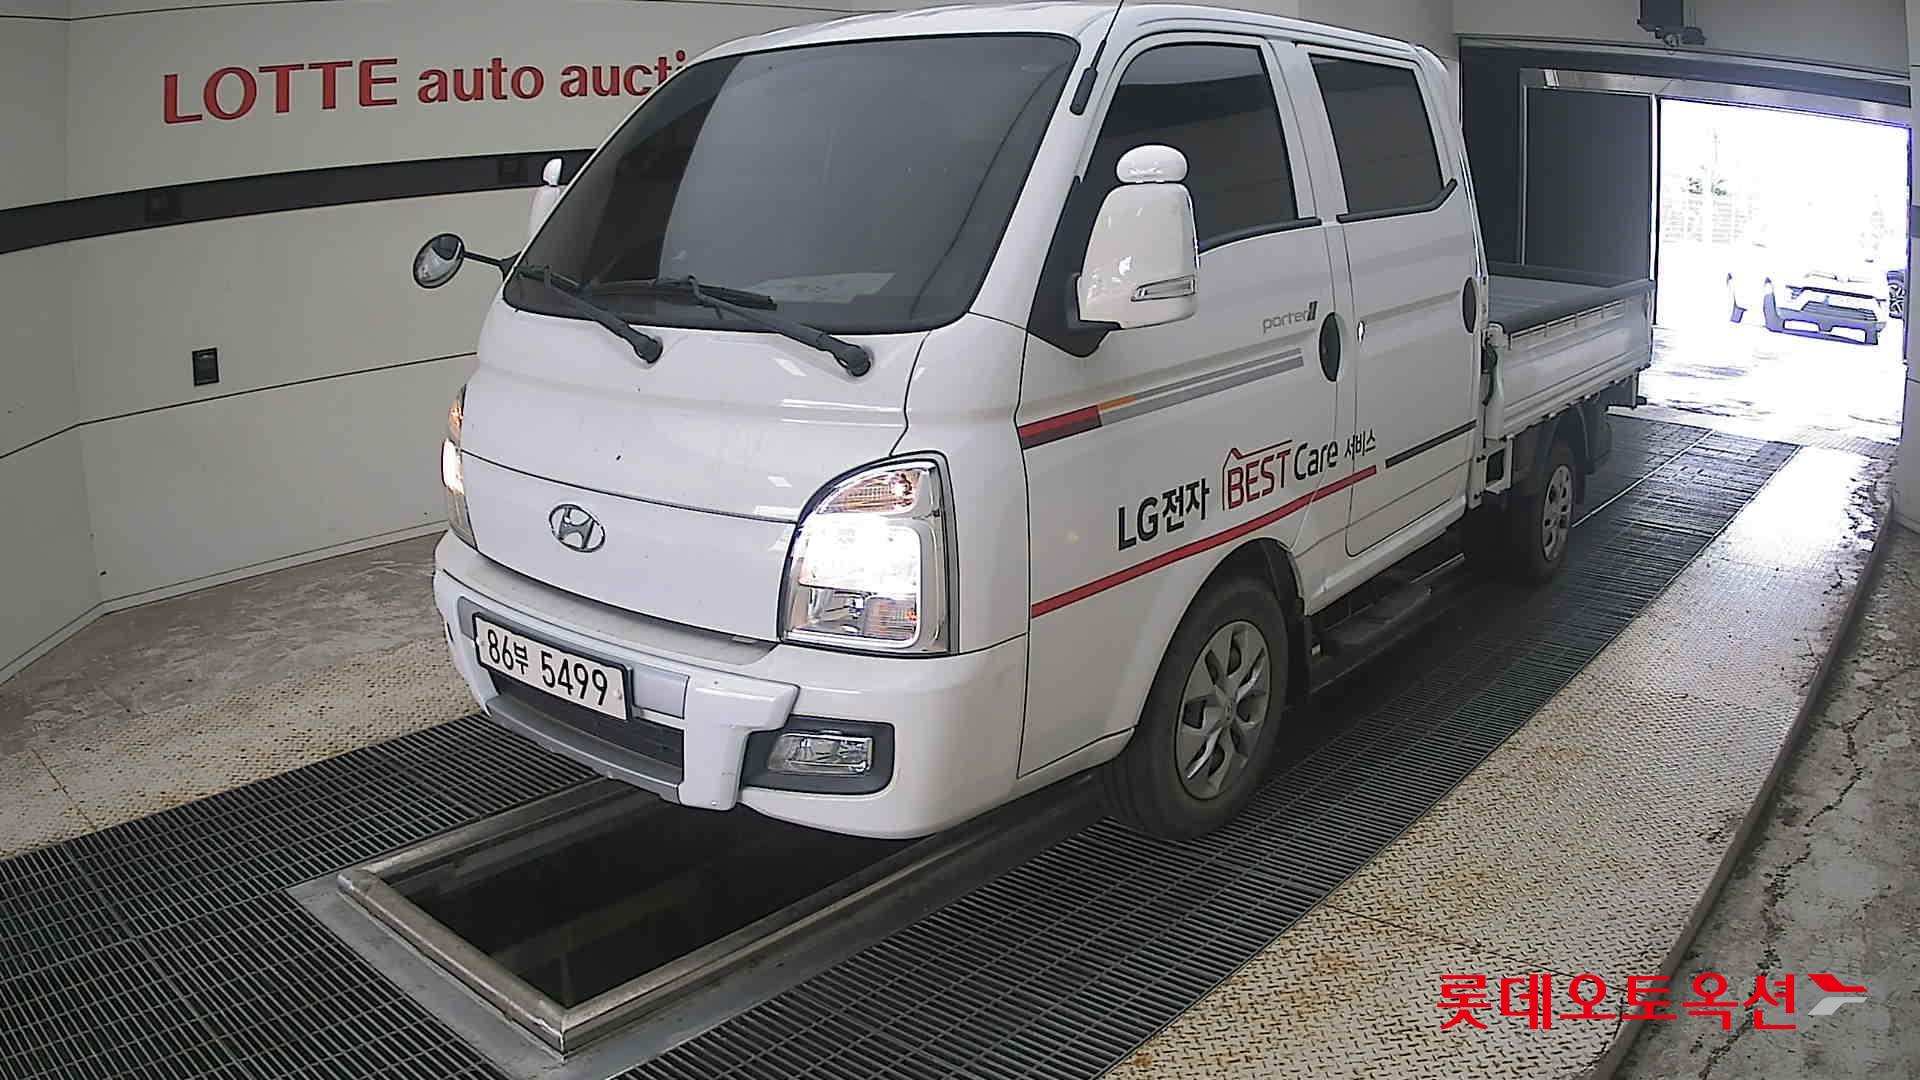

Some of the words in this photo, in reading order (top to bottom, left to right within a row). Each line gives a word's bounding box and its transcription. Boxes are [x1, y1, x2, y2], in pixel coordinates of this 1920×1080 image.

[164, 58, 398, 124] LOTTE
[417, 57, 544, 103] auto
[1118, 478, 1210, 551] LG전자
[1227, 449, 1291, 510] BEST
[1294, 440, 1339, 481] Care
[1344, 428, 1376, 461] 서비스
[487, 629, 528, 675] 86부
[541, 650, 608, 706] 5499
